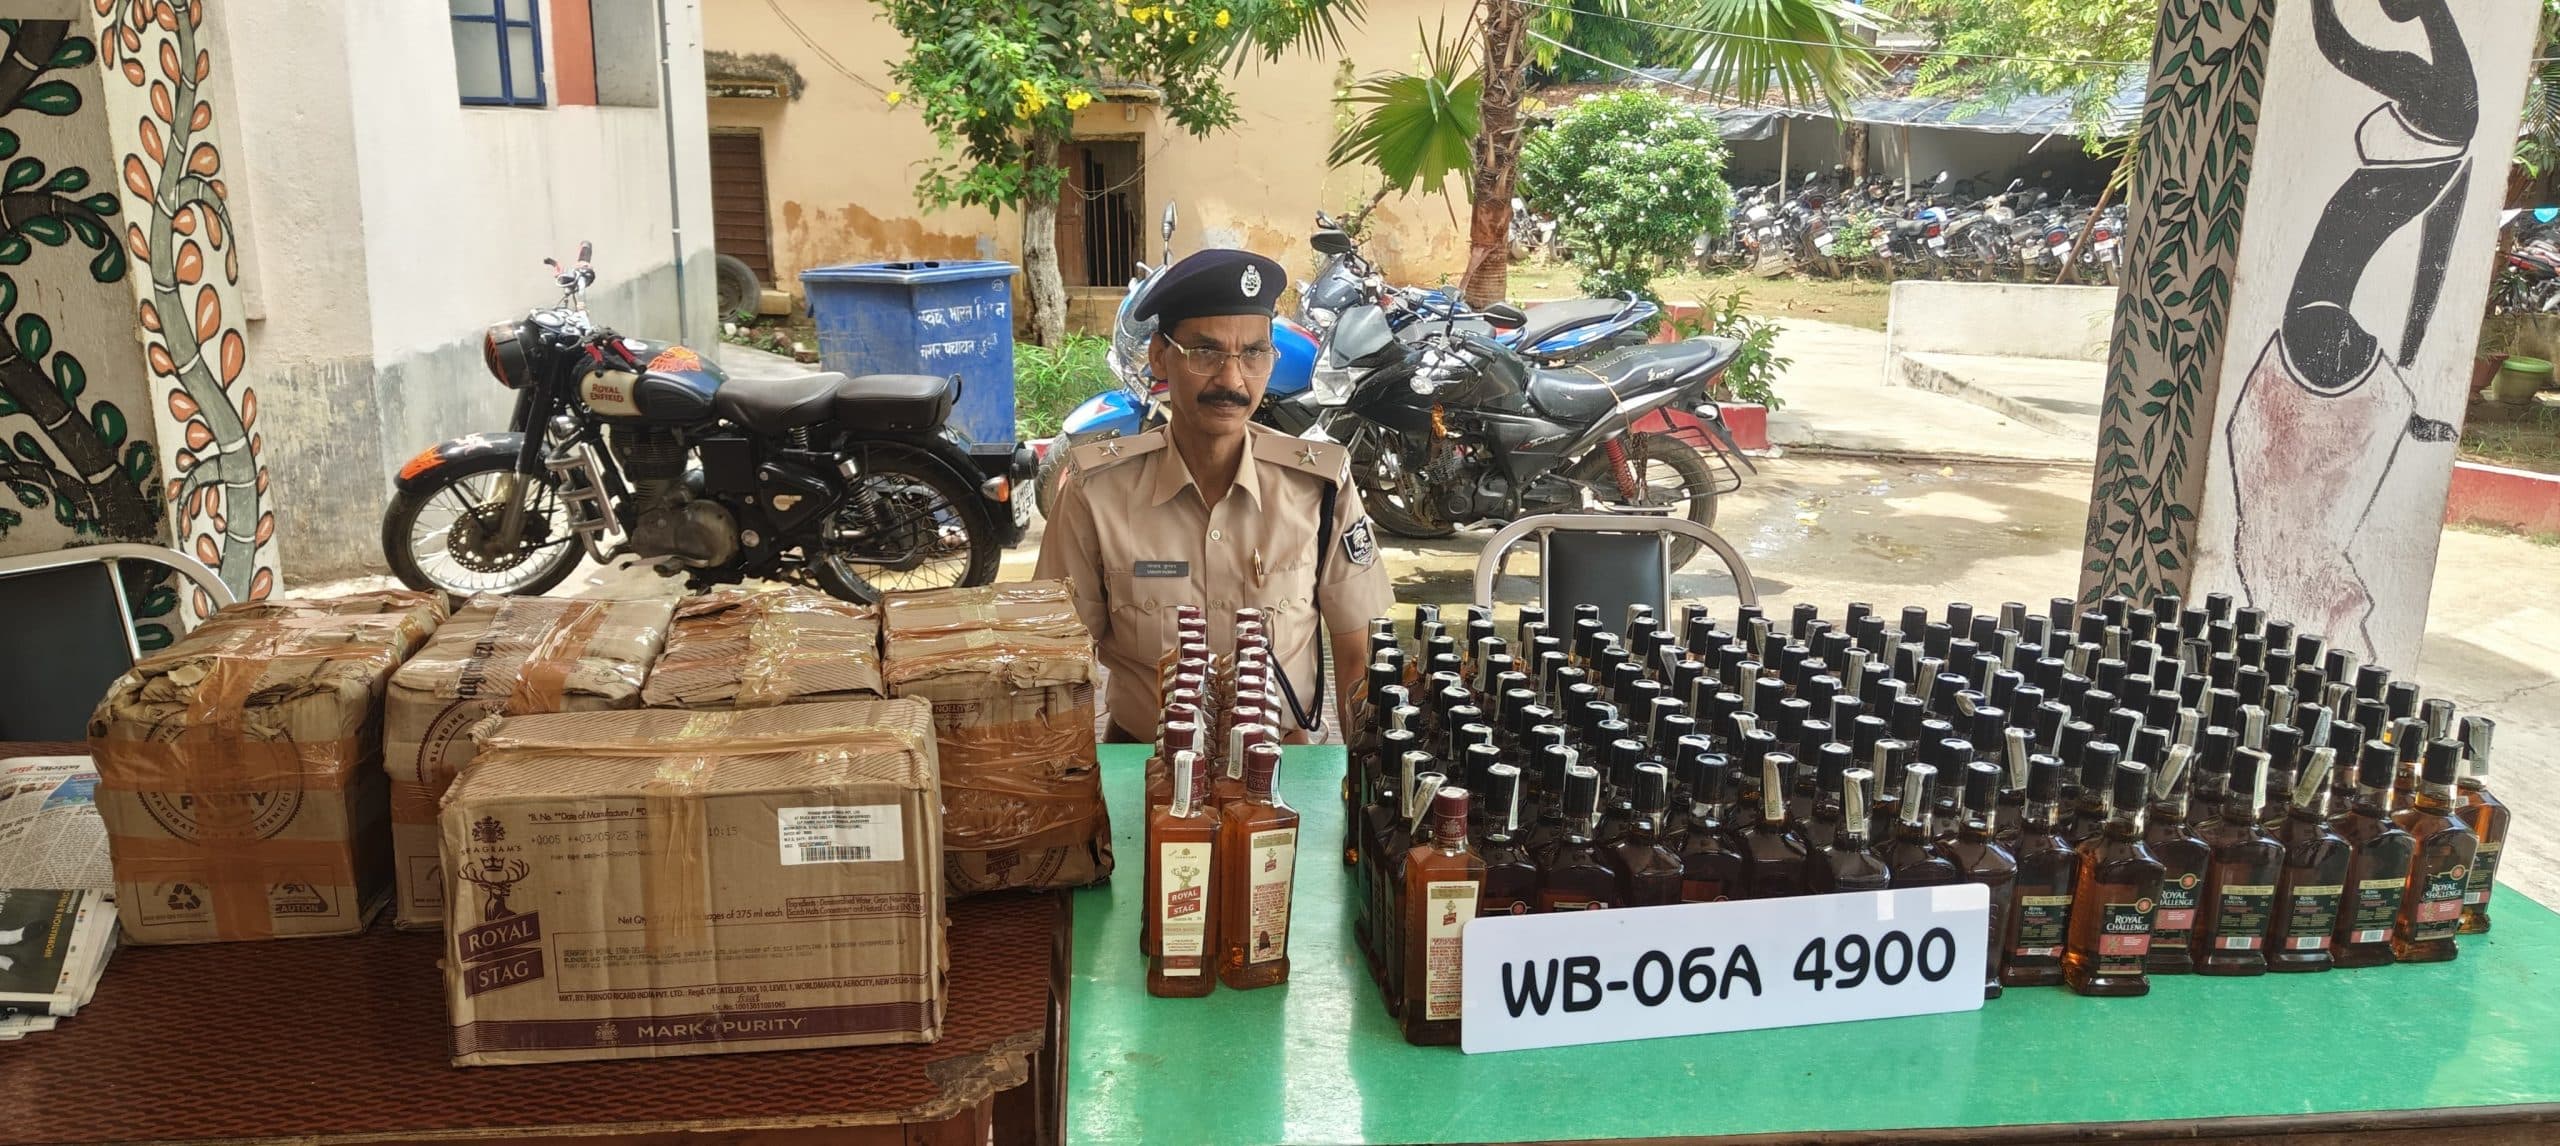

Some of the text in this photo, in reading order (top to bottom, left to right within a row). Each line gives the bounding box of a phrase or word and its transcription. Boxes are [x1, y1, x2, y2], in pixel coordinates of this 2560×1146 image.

[592, 383, 621, 393] ROYAL
[591, 392, 624, 403] ENFIELD
[934, 703, 976, 713] CAUTION
[430, 713, 465, 762] BLENDING
[2432, 882, 2457, 891] ROYAL
[1171, 888, 1198, 902] ROYAL
[1173, 903, 1195, 915] STAG
[617, 916, 632, 925] Net
[726, 910, 734, 919] of
[736, 908, 752, 918] 375
[753, 908, 763, 918] ml
[764, 908, 783, 917] each
[2114, 914, 2144, 924] ROYAL
[2106, 922, 2149, 931] CHALLENGE
[468, 920, 533, 952] ROYAL
[479, 960, 528, 988] STAG
[1501, 944, 1763, 1018] WB-06A
[1793, 927, 1956, 992] 4900
[613, 992, 637, 1000] RICARD
[769, 984, 788, 992] LEVEL
[875, 978, 890, 986] NEW
[638, 1023, 703, 1038] MARK
[723, 1018, 803, 1033] PURITY
